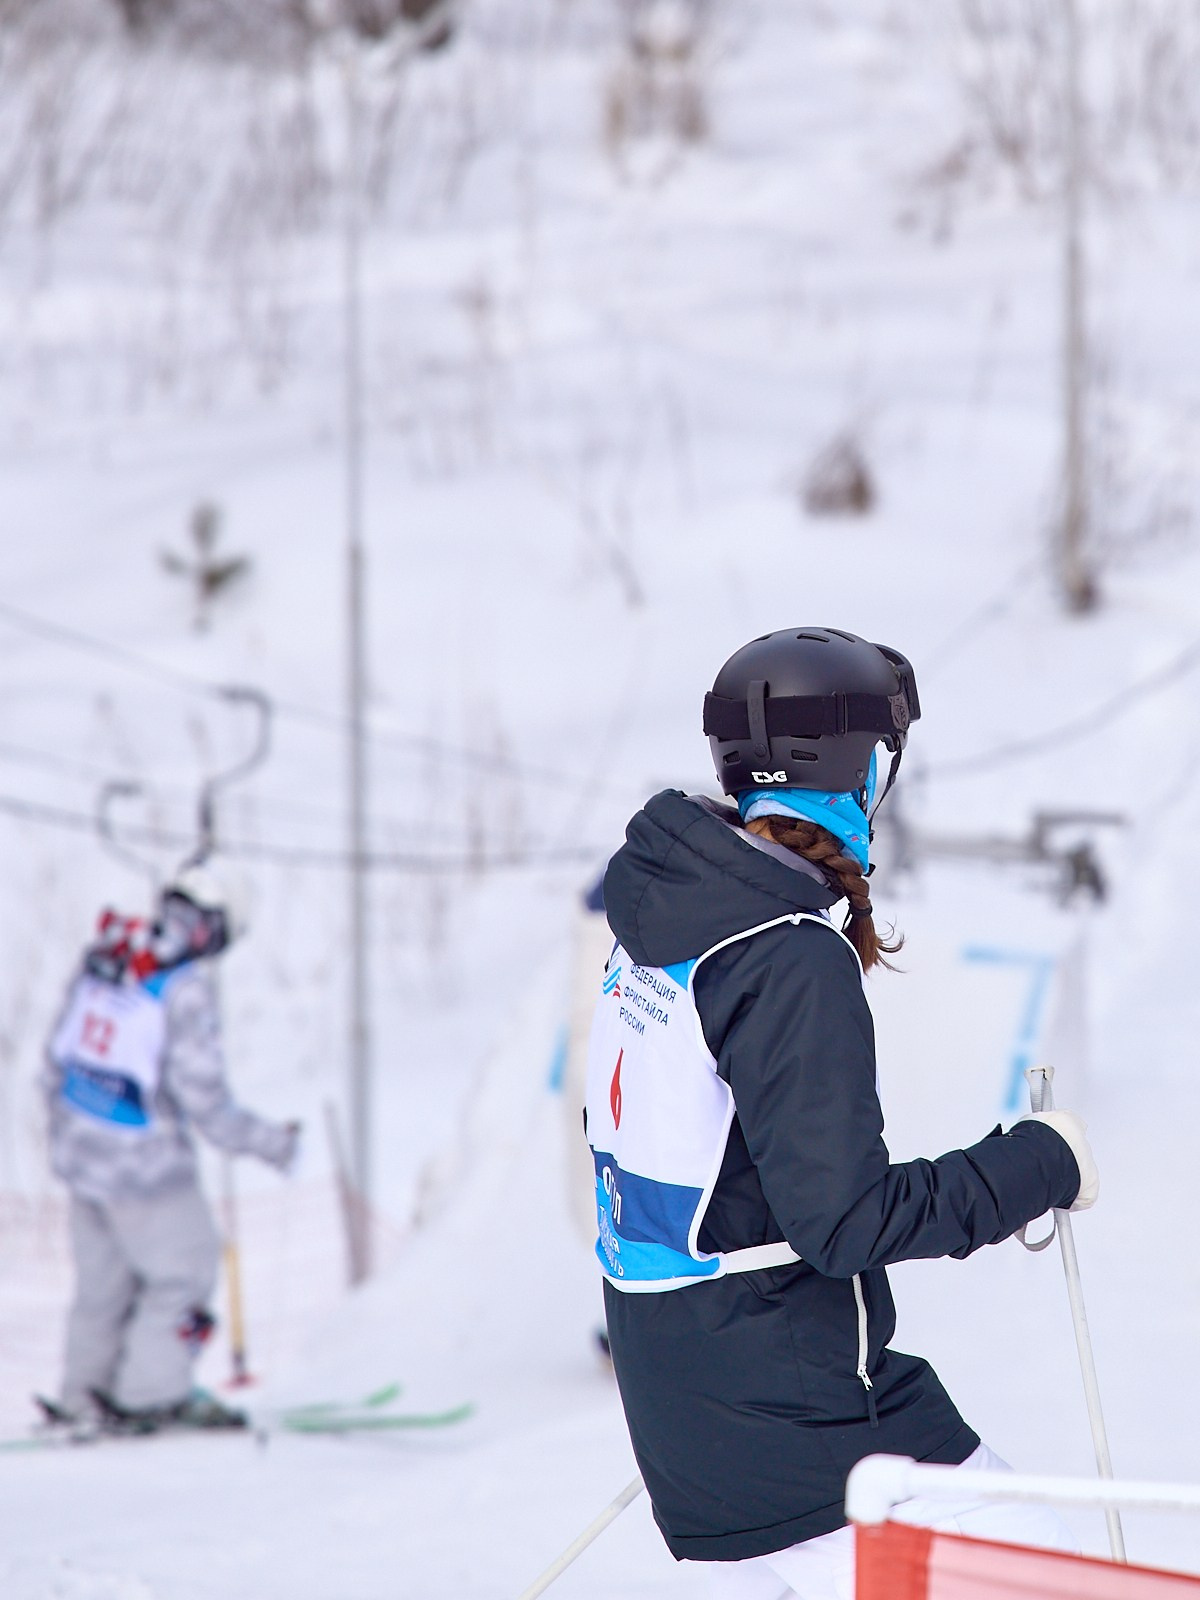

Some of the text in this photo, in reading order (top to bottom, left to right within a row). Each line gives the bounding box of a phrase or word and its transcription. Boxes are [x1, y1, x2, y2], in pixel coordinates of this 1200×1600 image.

[629, 963, 677, 1003] ФЕДЕРАЦИЯ
[619, 1007, 646, 1036] РОССИИ
[623, 986, 669, 1026] ФРИСТАЙЛА
